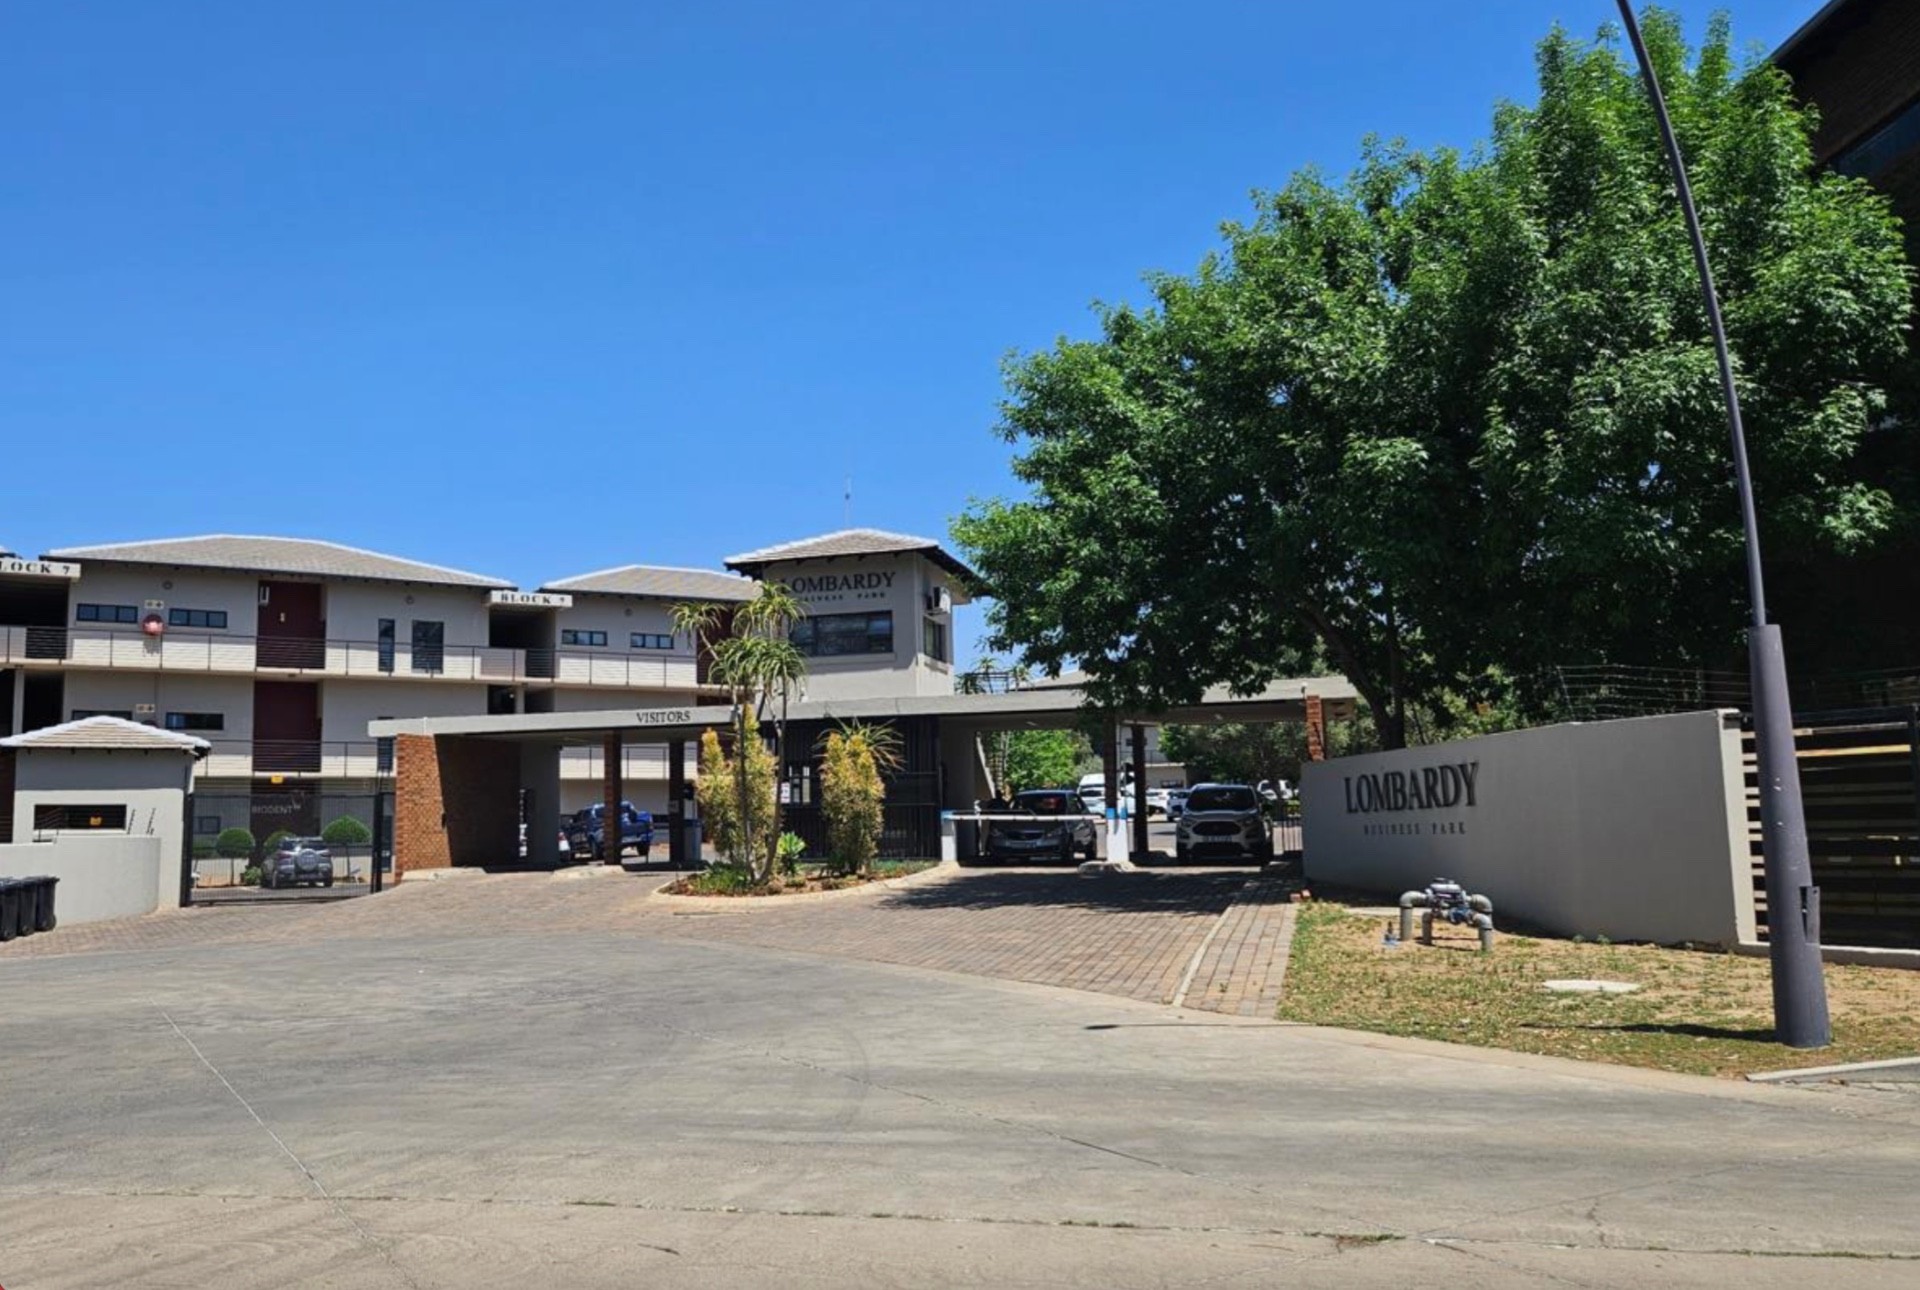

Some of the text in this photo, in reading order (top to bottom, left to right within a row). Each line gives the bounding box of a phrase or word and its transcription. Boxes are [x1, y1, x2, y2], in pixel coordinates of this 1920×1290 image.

[501, 594, 551, 604] BLOCK
[636, 710, 691, 723] VISITORS
[1344, 762, 1479, 813] LOMBARDY
[1363, 821, 1467, 835] BUSINESS PARK
